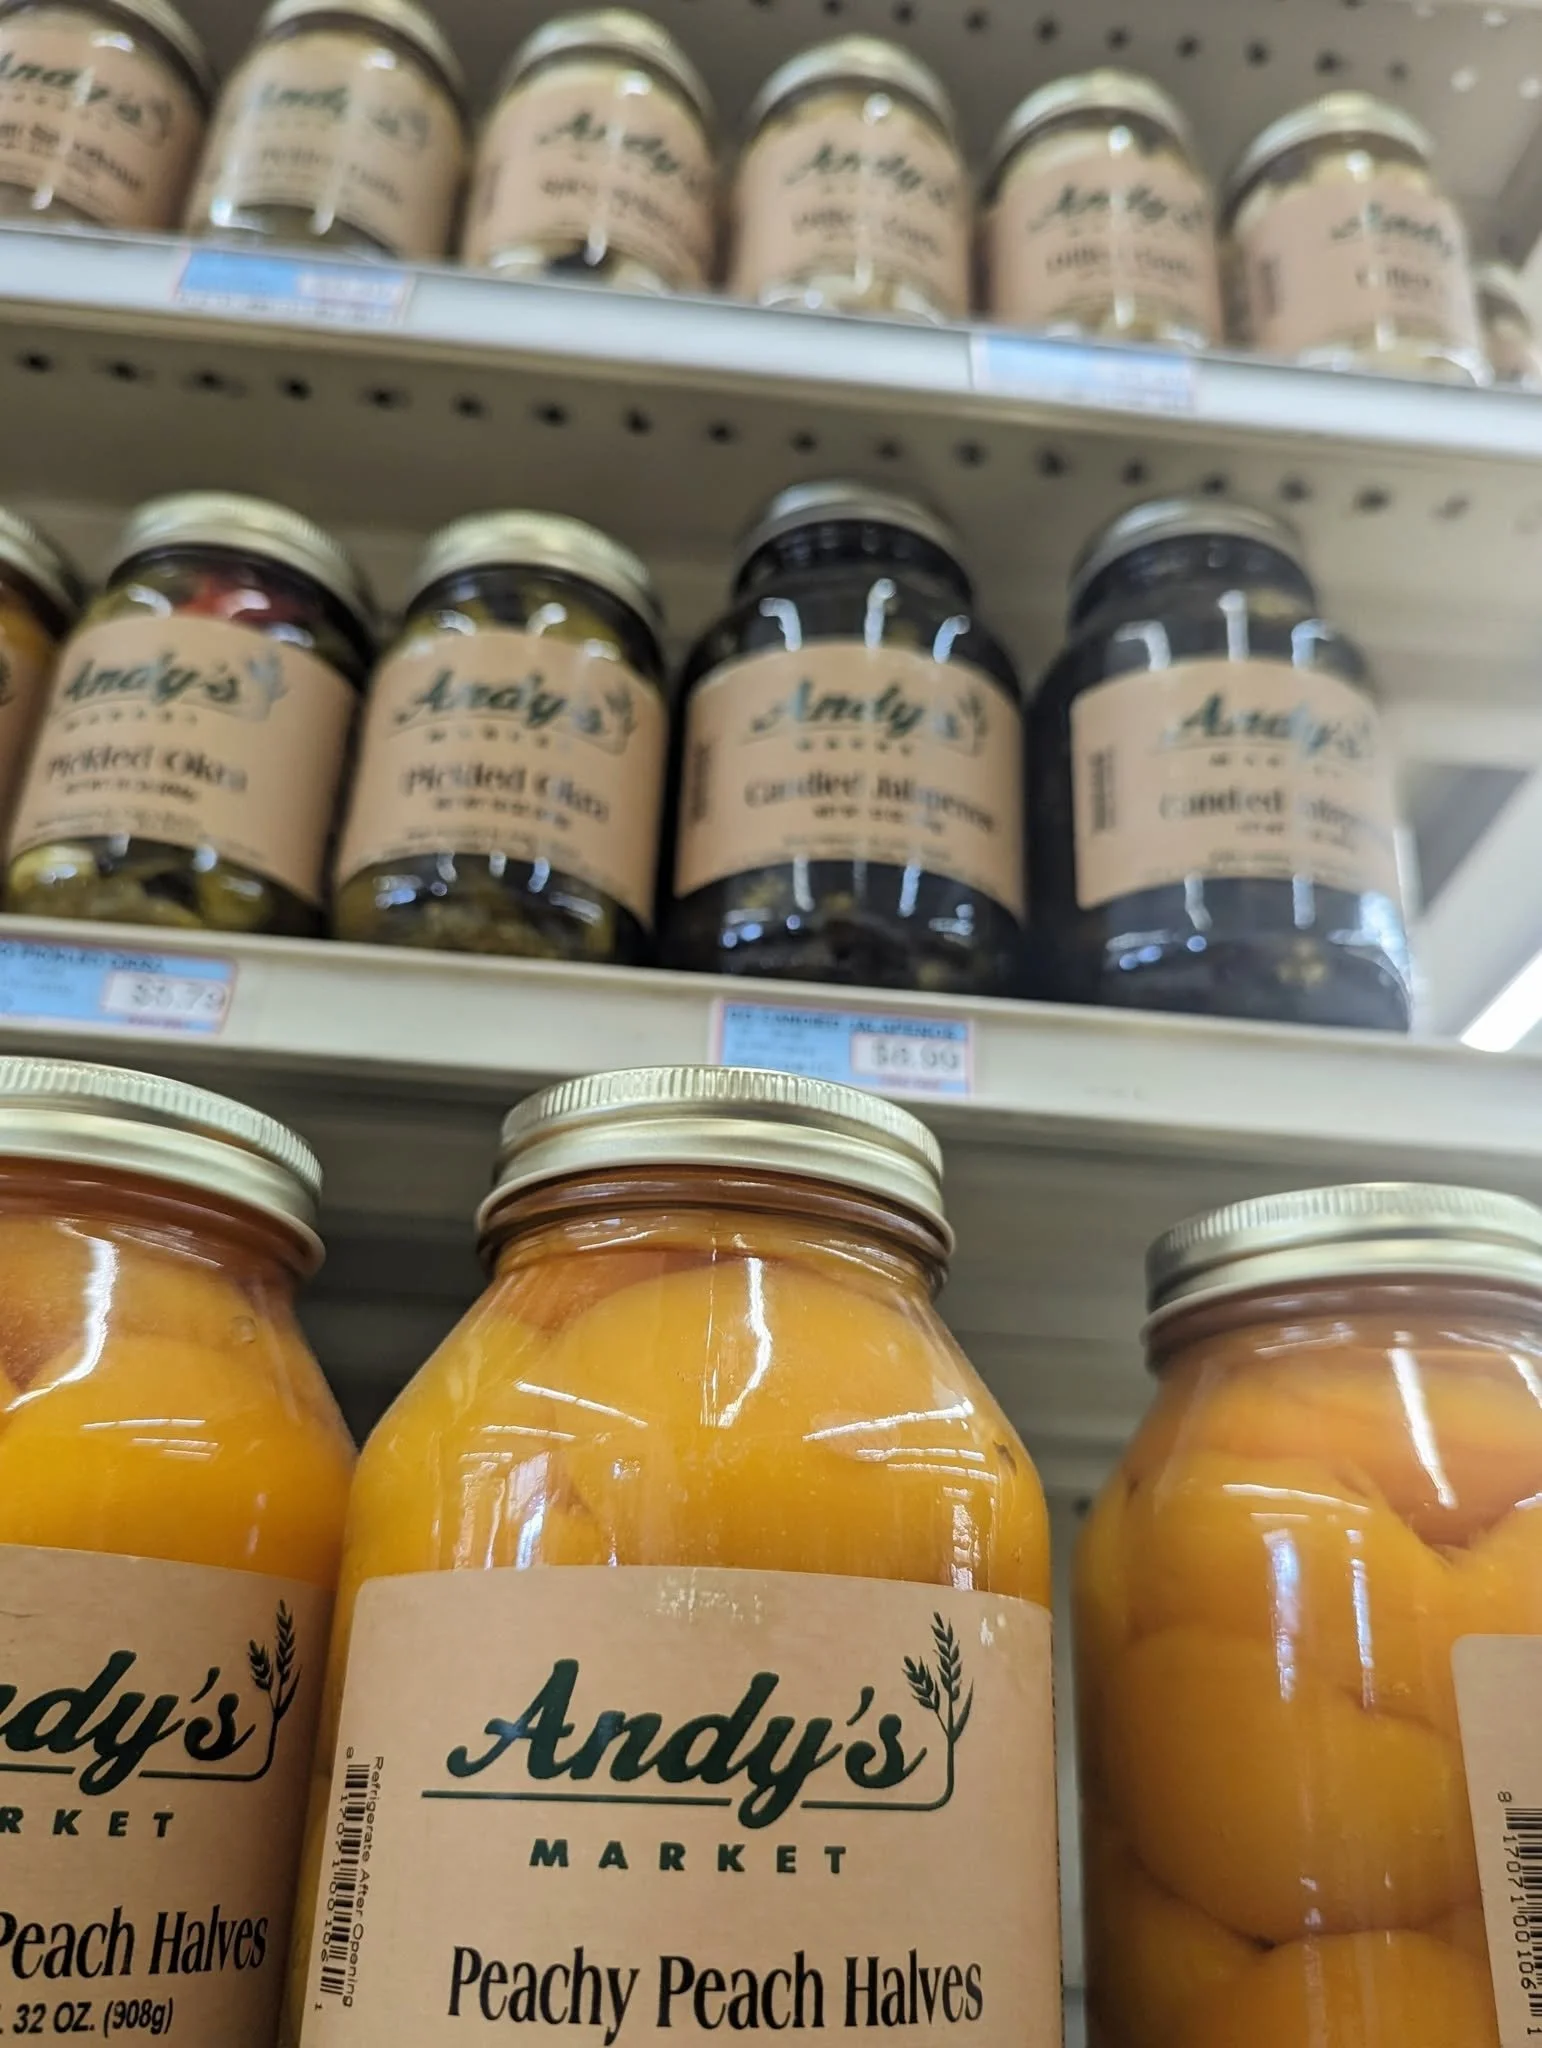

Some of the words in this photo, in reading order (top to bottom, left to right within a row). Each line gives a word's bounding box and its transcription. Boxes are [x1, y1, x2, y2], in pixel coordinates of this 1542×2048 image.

[63, 650, 240, 706] Andy's
[446, 1658, 927, 1829] Andy's
[332, 1794, 350, 1868] 17071
[360, 1756, 384, 1863] Refrigerate
[1498, 1791, 1512, 1802] 8
[529, 1838, 847, 1875] MARKET
[1503, 1835, 1528, 1904] 17071
[319, 1881, 338, 1963] 00106
[354, 1868, 371, 1919] After
[148, 1903, 268, 1976] Halves
[341, 1923, 364, 2009] Opening
[1513, 1913, 1538, 1992] 00106
[12, 2002, 47, 2034] 32
[53, 2001, 95, 2033] OZ.
[103, 1997, 174, 2038] (908g)
[447, 1945, 640, 2047] Peachy
[656, 1949, 824, 2030] Peach
[843, 1948, 984, 2028] Halves
